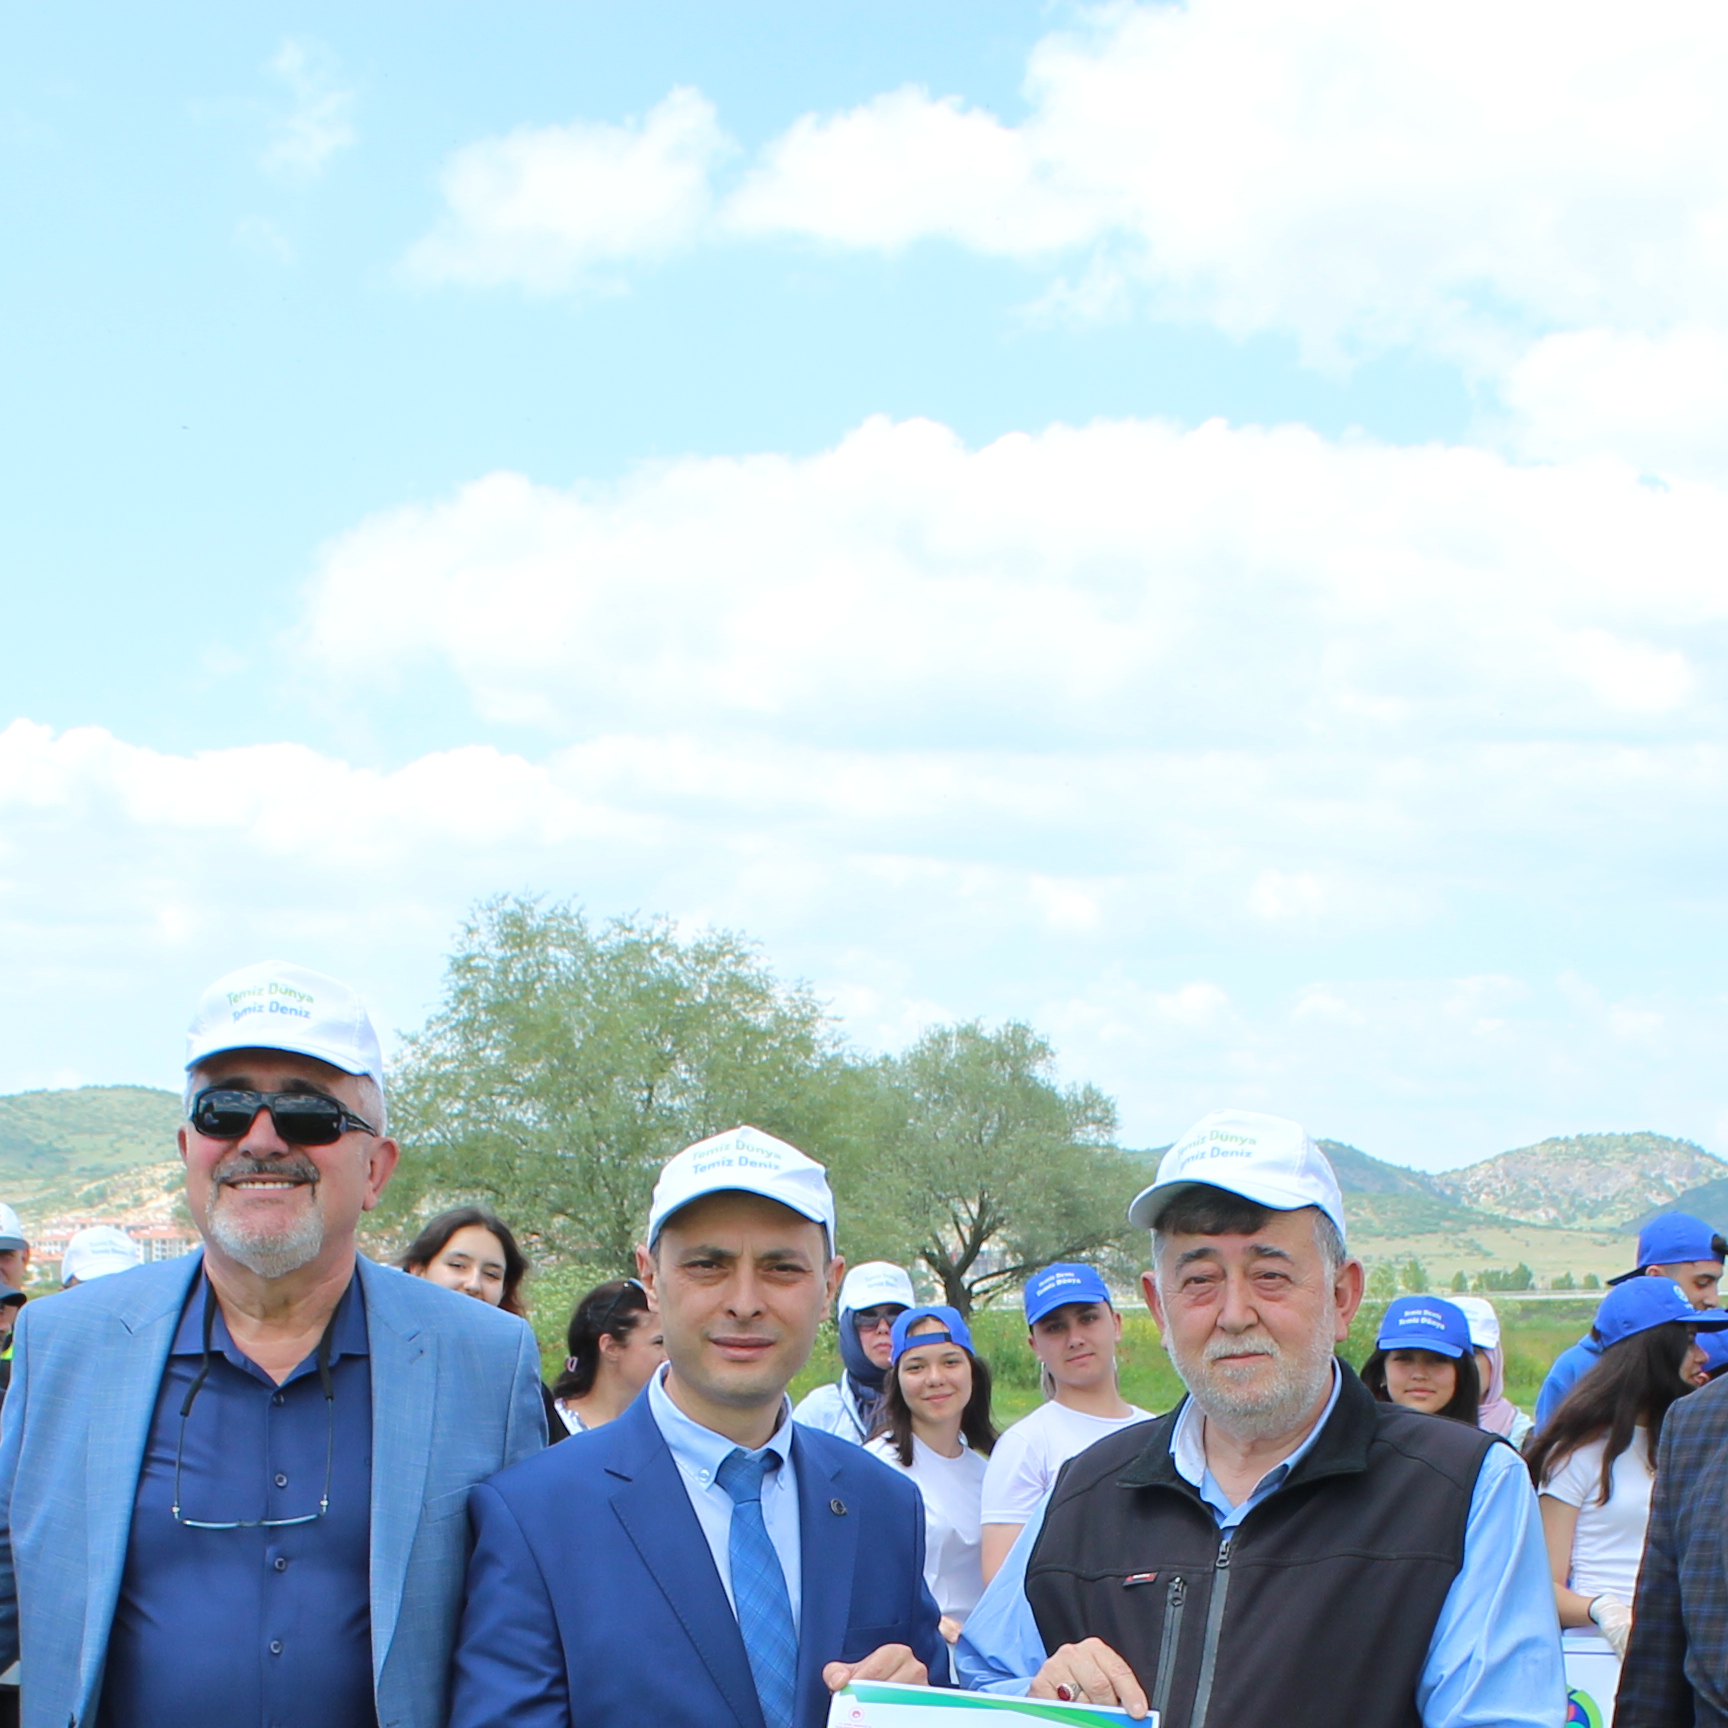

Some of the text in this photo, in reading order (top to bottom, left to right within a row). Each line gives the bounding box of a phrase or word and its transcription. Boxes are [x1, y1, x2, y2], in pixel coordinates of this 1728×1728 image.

[268, 982, 315, 1003] Dünya
[268, 1000, 311, 1019] Deniz
[1209, 1129, 1257, 1146] Dünya
[735, 1138, 782, 1159] Dünya
[1210, 1146, 1253, 1159] Deniz
[692, 1155, 780, 1175] Temiz Deniz
